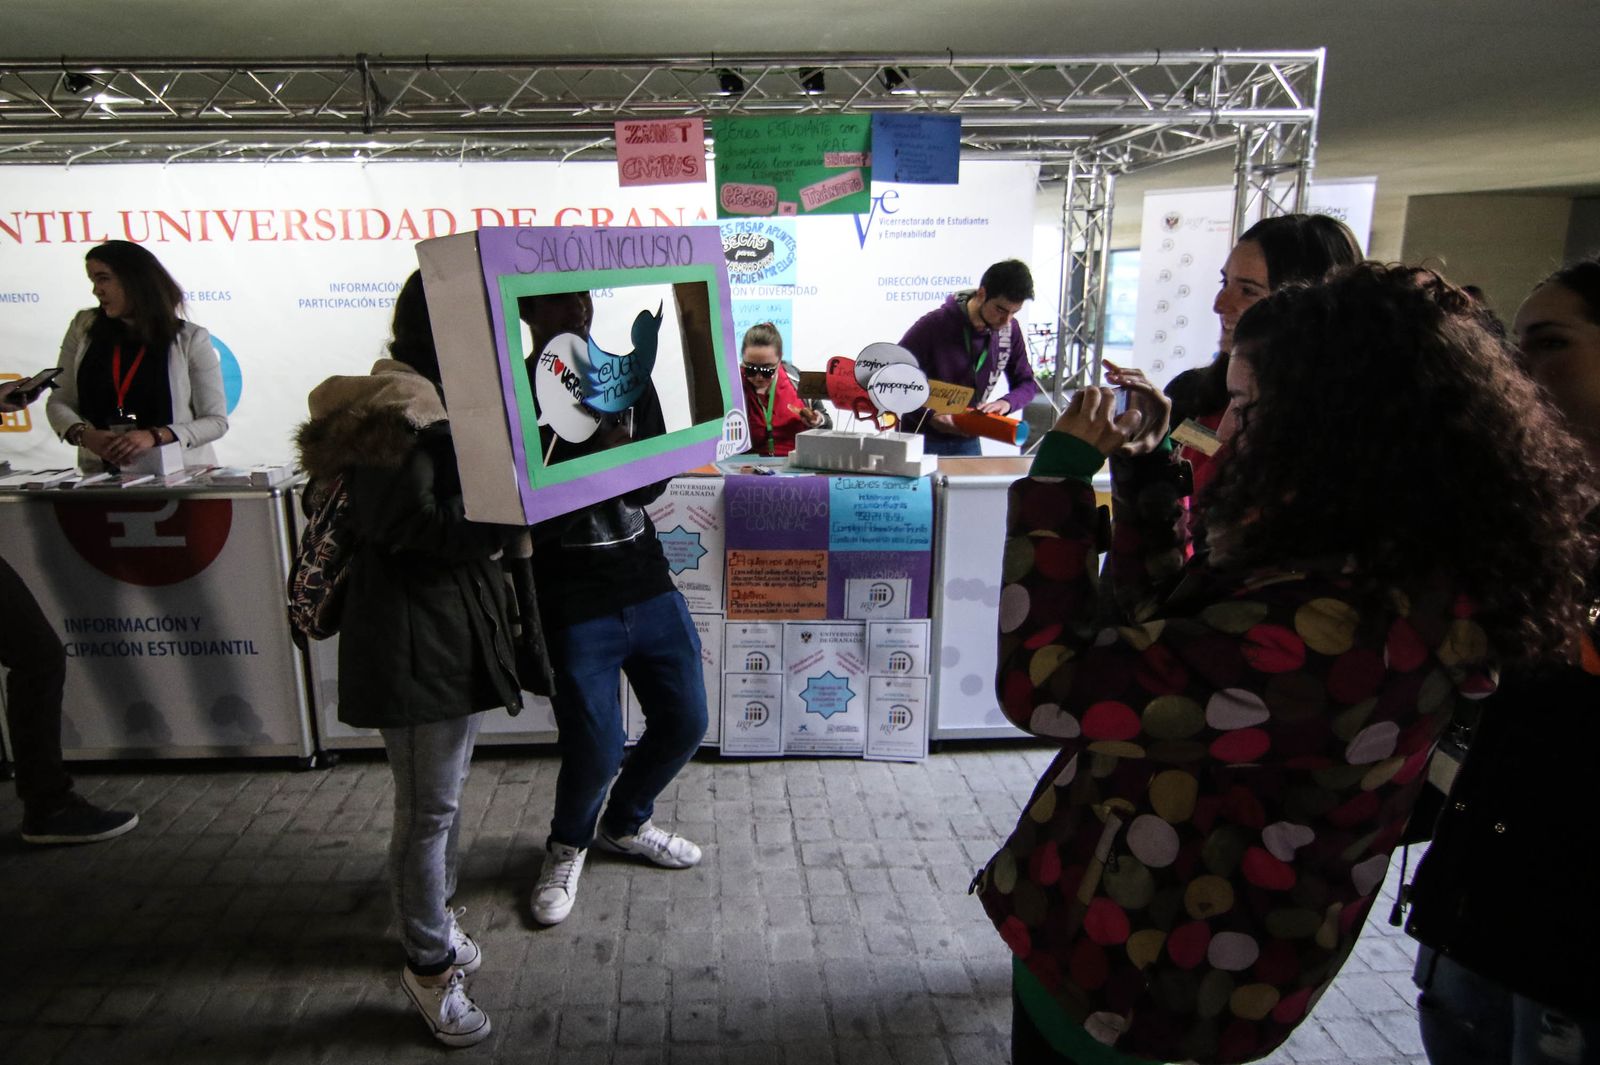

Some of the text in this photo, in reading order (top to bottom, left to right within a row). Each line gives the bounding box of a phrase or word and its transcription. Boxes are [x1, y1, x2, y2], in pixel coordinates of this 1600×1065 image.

[117, 207, 457, 243] UNIVERSIDAD
[735, 221, 765, 233] PASAR
[879, 216, 990, 226] Vicerrectorado de Estudiantes
[878, 230, 936, 240] y Empleabilidad
[878, 274, 974, 287] DIRECCIÓN GENERAL
[329, 281, 403, 293] INFORMACIÓN
[758, 285, 818, 297] DIVERSIDAD
[198, 291, 232, 302] BECAS
[886, 291, 898, 302] DE
[298, 297, 376, 309] PARTICIPACIÓN
[65, 615, 201, 634] INFORMACIÓN Y
[148, 640, 259, 657] ESTUDIANTIL
